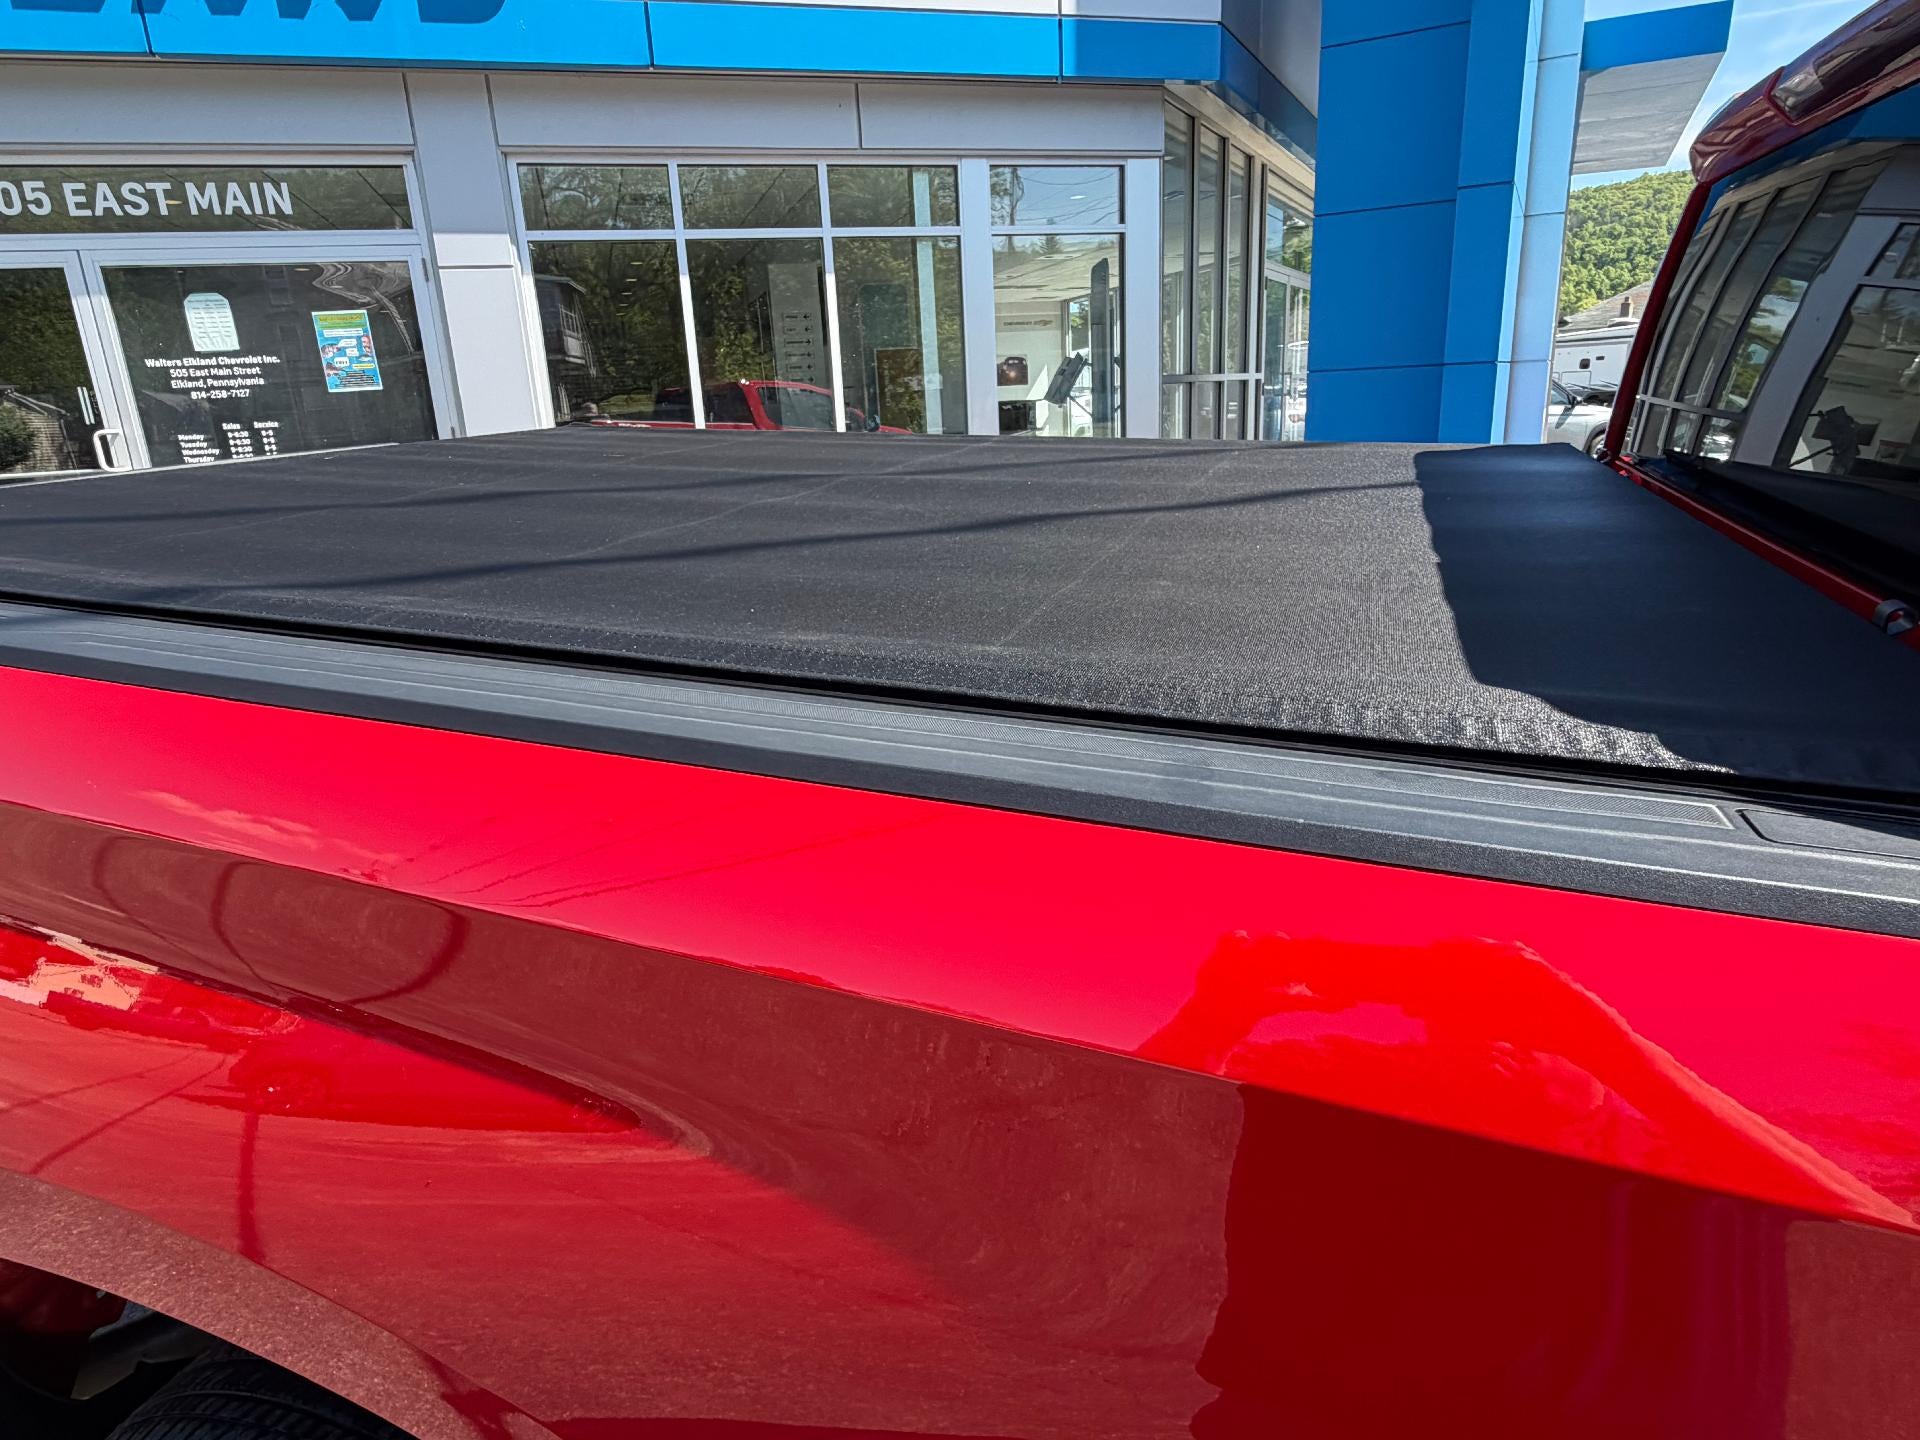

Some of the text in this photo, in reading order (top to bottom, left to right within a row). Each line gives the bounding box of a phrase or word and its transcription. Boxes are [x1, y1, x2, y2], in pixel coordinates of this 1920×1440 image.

[62, 182, 172, 217] EAST
[184, 181, 294, 216] MAIN
[145, 355, 280, 368] Walters Elkland Chevrolet Inc.
[170, 366, 261, 378] 505 East Main Street
[171, 377, 265, 389] Elkland, Pennsylvania
[184, 455, 215, 463] Thursday
